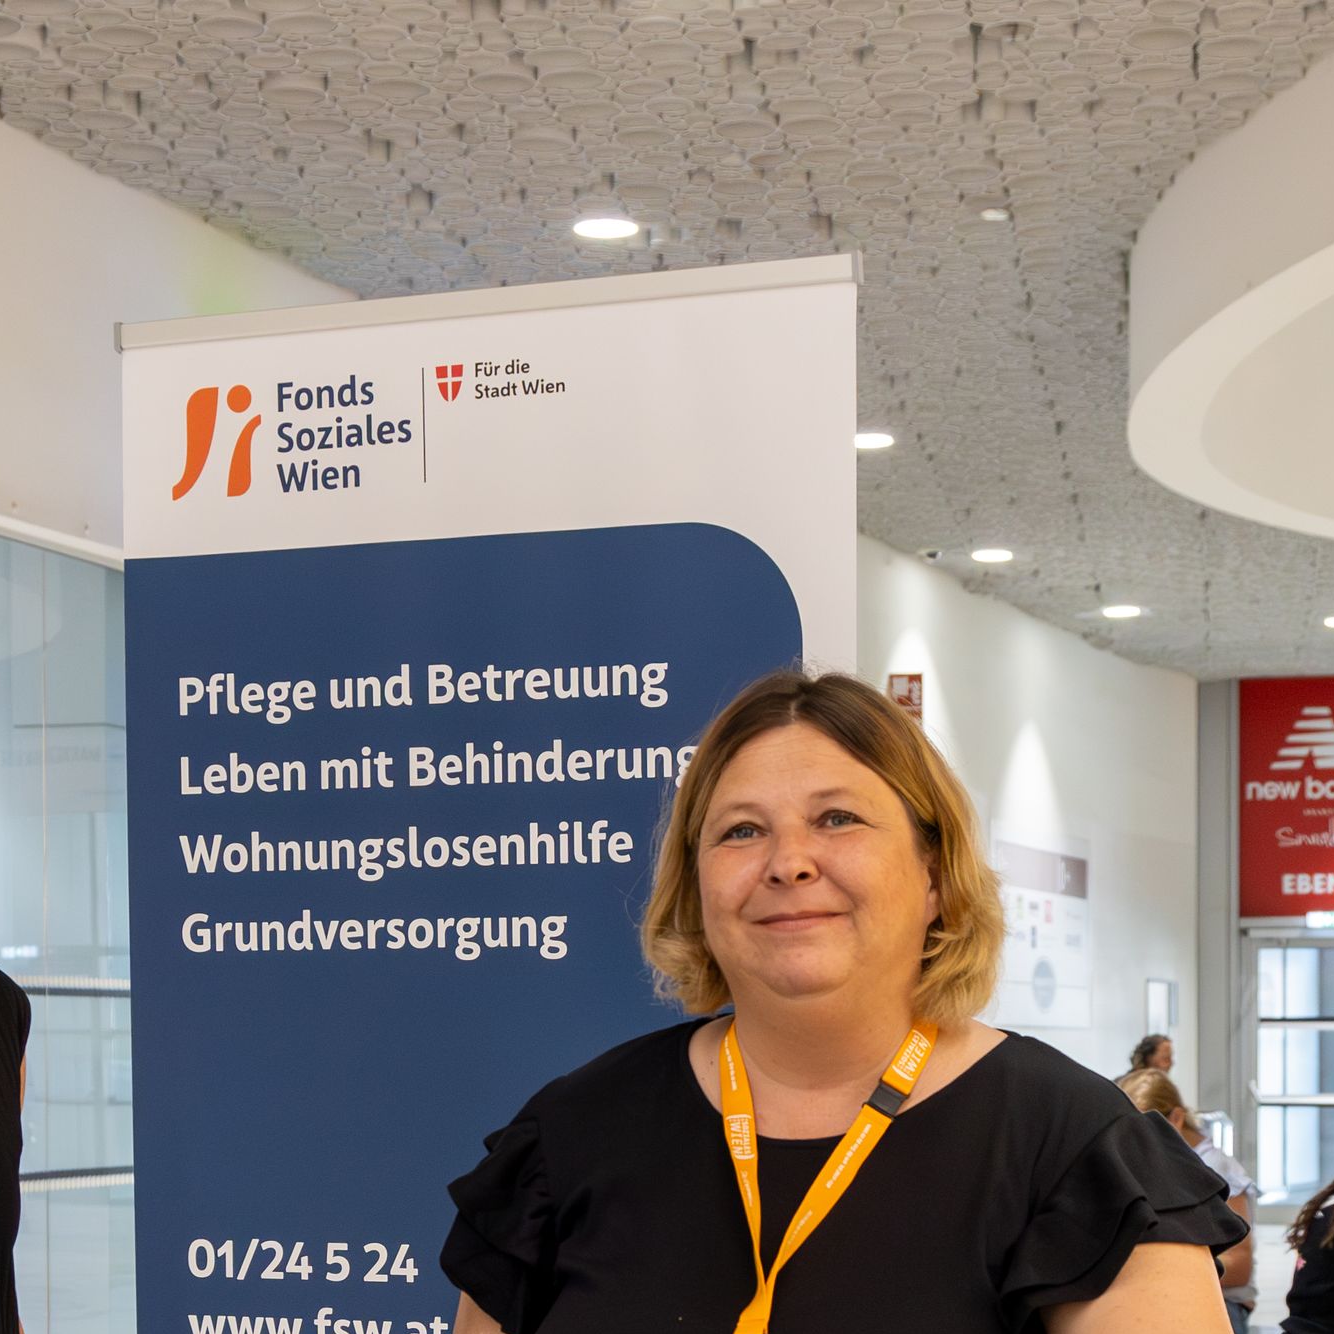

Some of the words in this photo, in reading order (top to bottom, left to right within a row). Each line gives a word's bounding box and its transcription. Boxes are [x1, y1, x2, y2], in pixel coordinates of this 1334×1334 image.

[474, 360, 501, 378] Für
[505, 358, 530, 376] die
[277, 375, 374, 412] Fonds
[474, 380, 517, 400] Stadt
[521, 377, 565, 396] Wien
[277, 414, 412, 453] Soziales
[277, 461, 361, 493] Wien
[178, 673, 316, 724] Pflege
[329, 665, 412, 710] und
[427, 660, 668, 708] Betreuung
[180, 755, 307, 795] Leben
[321, 746, 393, 790] mit
[1245, 781, 1300, 800] new
[179, 820, 634, 881] Wohnungslosenhilfe
[181, 911, 568, 960] Grundversorgung
[907, 1039, 929, 1073] WIEN
[187, 1238, 313, 1281] 01/24
[325, 1242, 351, 1282] 5
[363, 1242, 419, 1283] 24
